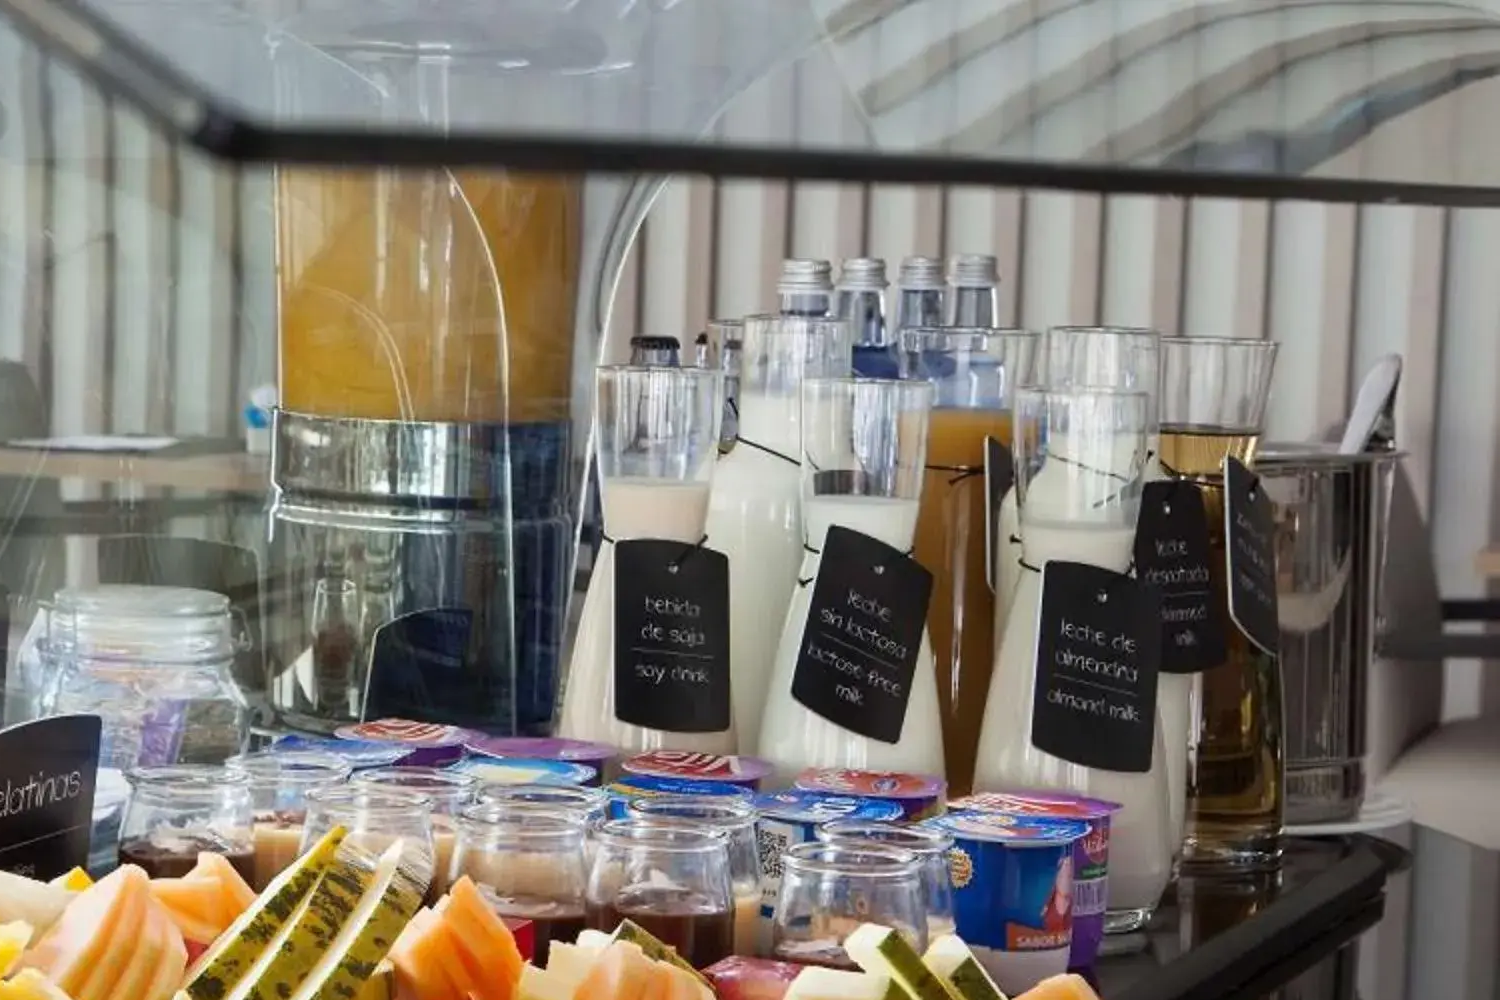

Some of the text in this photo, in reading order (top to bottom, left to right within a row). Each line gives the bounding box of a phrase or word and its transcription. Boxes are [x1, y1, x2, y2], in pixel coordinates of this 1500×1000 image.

[645, 596, 701, 617] bebida
[847, 589, 892, 622] leche
[641, 623, 664, 640] de
[820, 607, 907, 659] sin lactosa
[1060, 617, 1138, 654] leche de
[635, 664, 709, 684] soy drink
[807, 641, 864, 679] lactose
[835, 684, 865, 706] milk
[1046, 688, 1141, 722] almond milk
